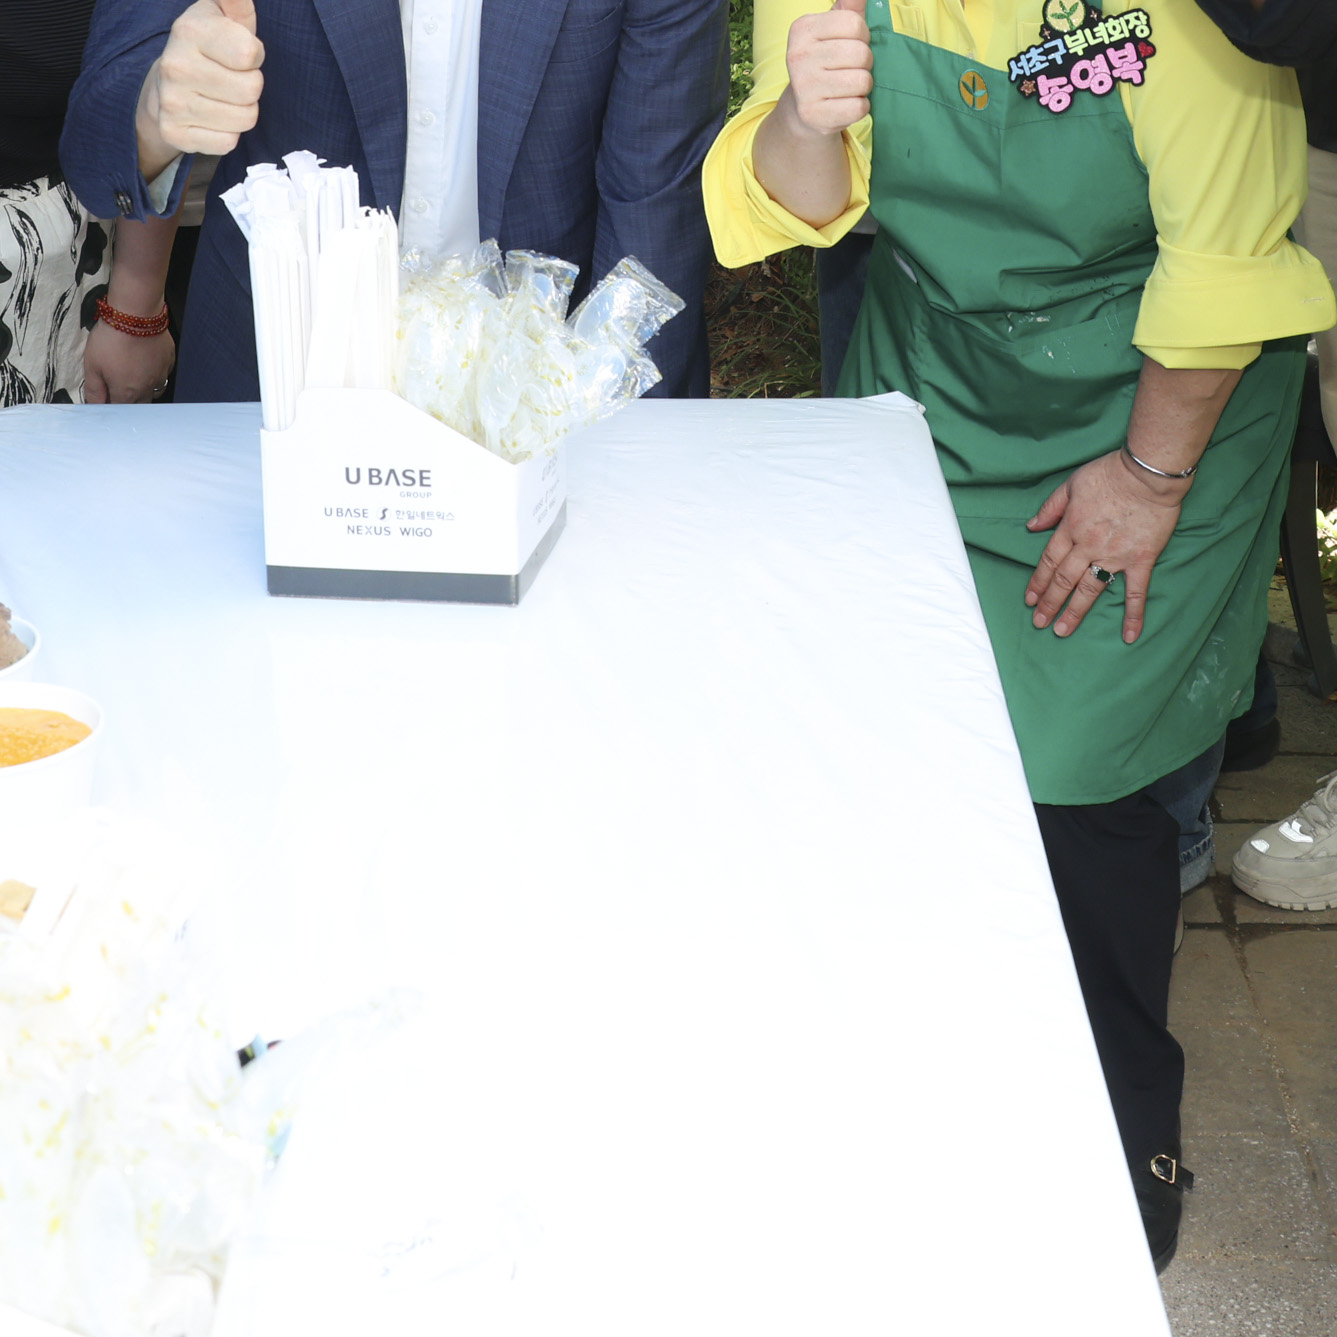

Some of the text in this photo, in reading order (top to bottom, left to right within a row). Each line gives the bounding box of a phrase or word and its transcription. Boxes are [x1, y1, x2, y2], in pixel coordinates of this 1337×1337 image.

[1009, 11, 1151, 82] 서초구 부녀회장
[399, 491, 432, 499] GROUP
[347, 524, 433, 538] NEXUS WIGO
